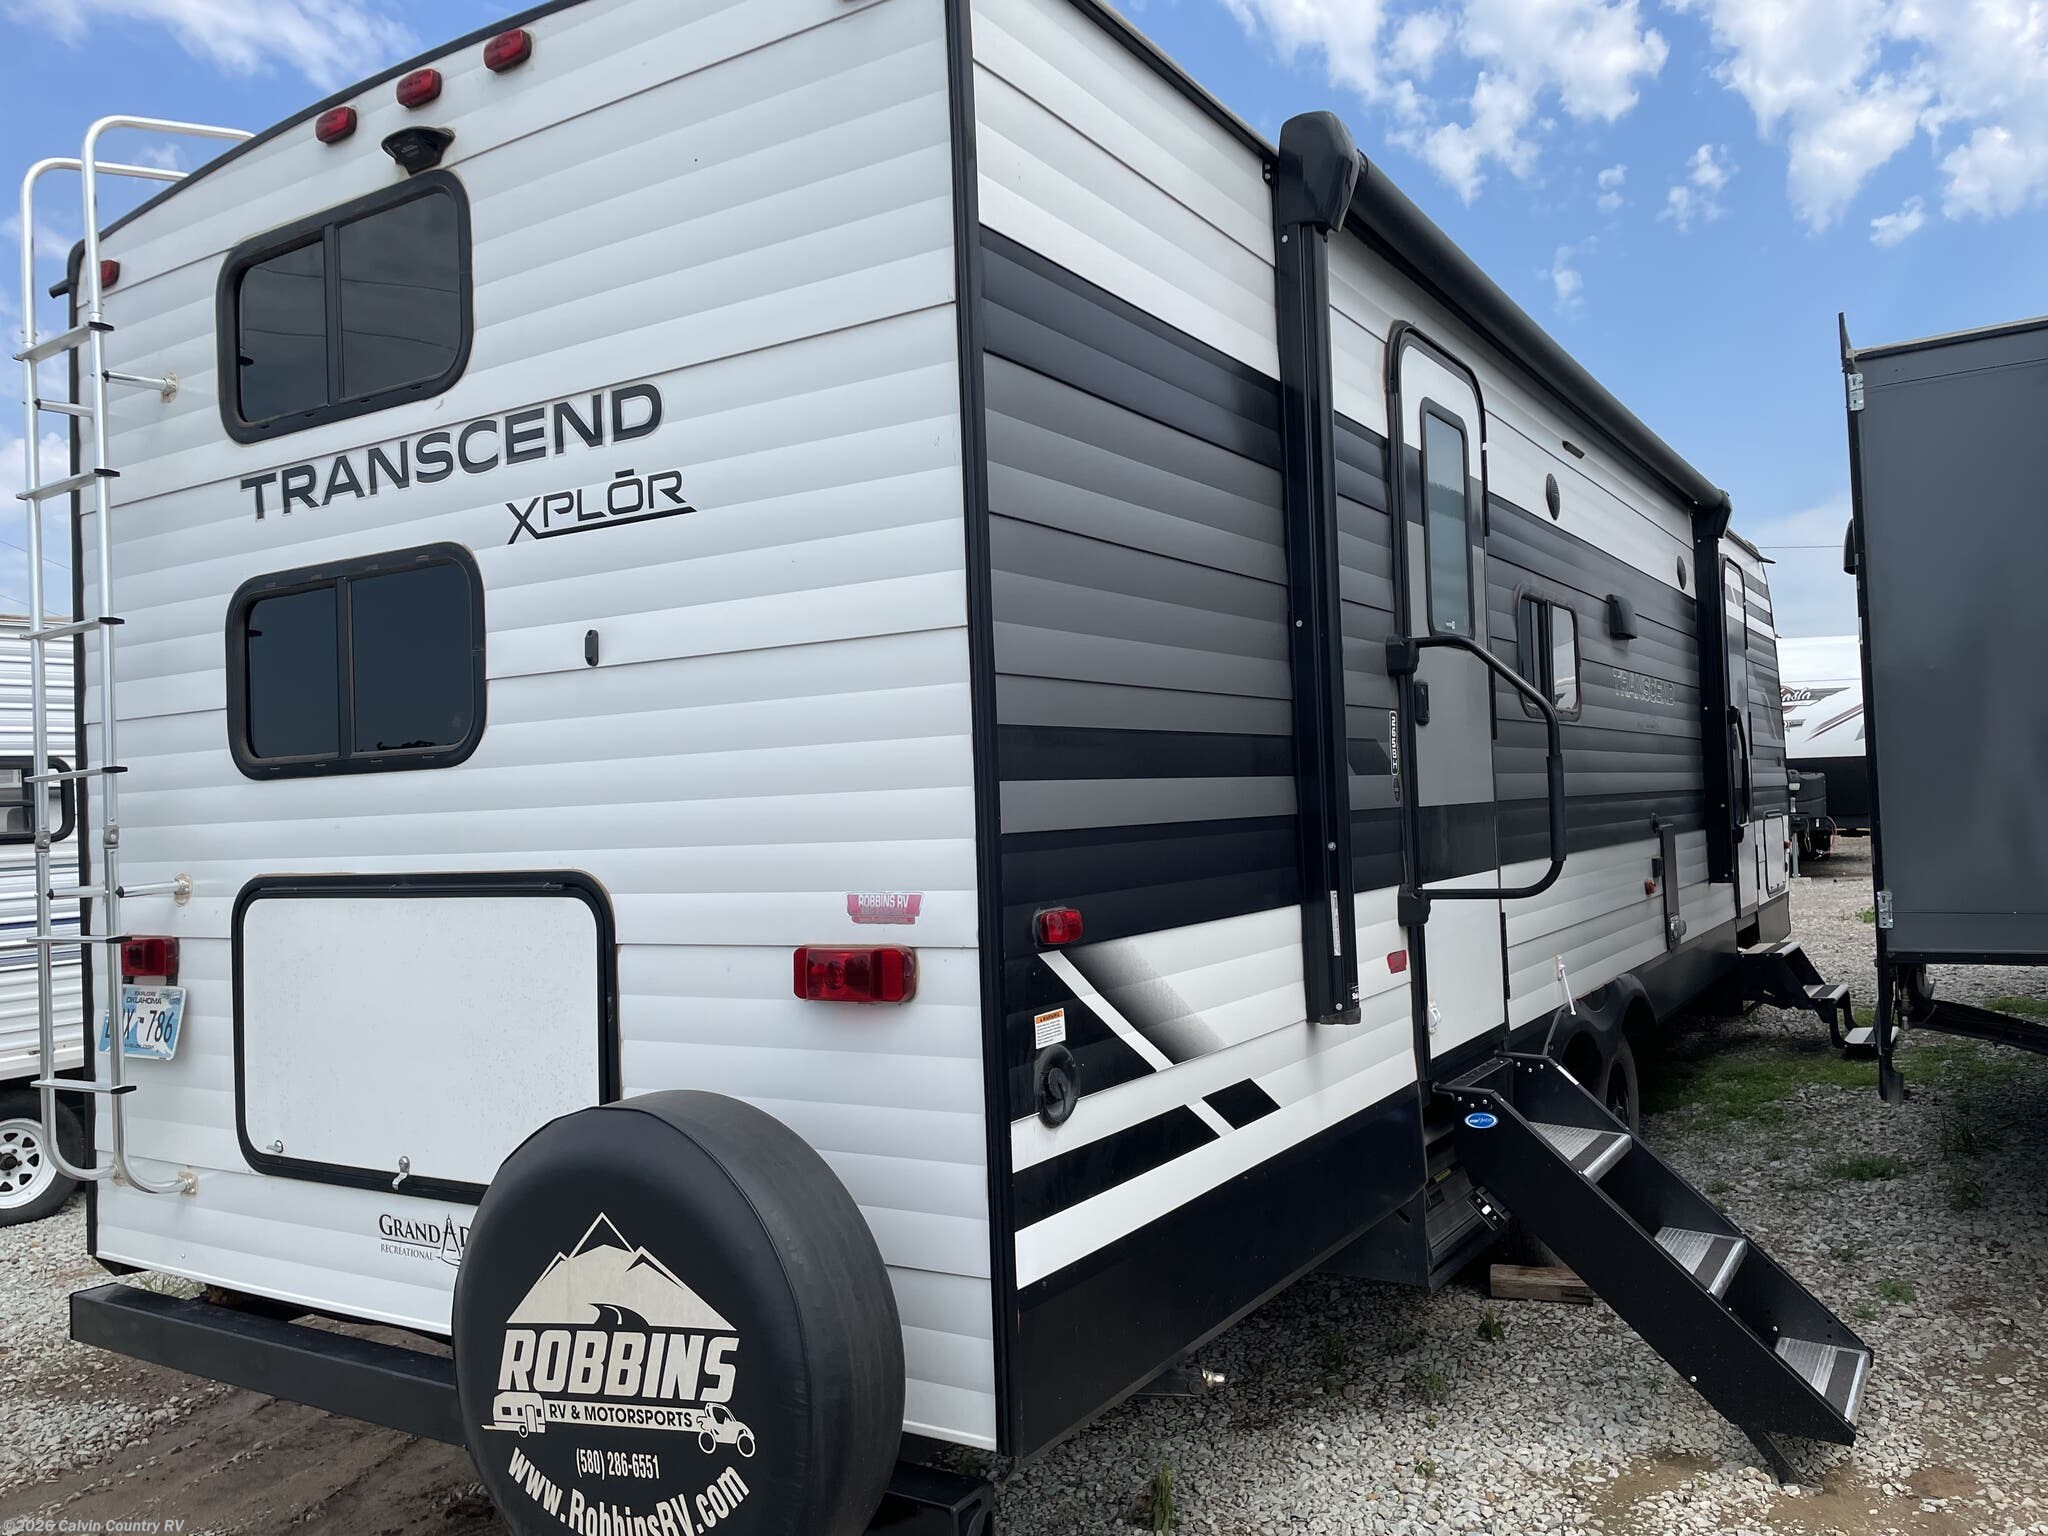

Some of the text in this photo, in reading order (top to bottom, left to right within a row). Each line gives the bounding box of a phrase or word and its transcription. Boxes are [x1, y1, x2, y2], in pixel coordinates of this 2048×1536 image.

[241, 384, 662, 520] TRANSCEND
[1613, 668, 1674, 706] TRANSCEND
[858, 895, 909, 908] ROBBINS RV
[126, 997, 161, 1005] OKLAHOMA
[380, 1243, 433, 1260] RECREATIONAL
[498, 1329, 740, 1403] ROBBINS
[550, 1403, 692, 1428] RV & MOTORSPORTS
[576, 1447, 660, 1480] (580) 286-6551
